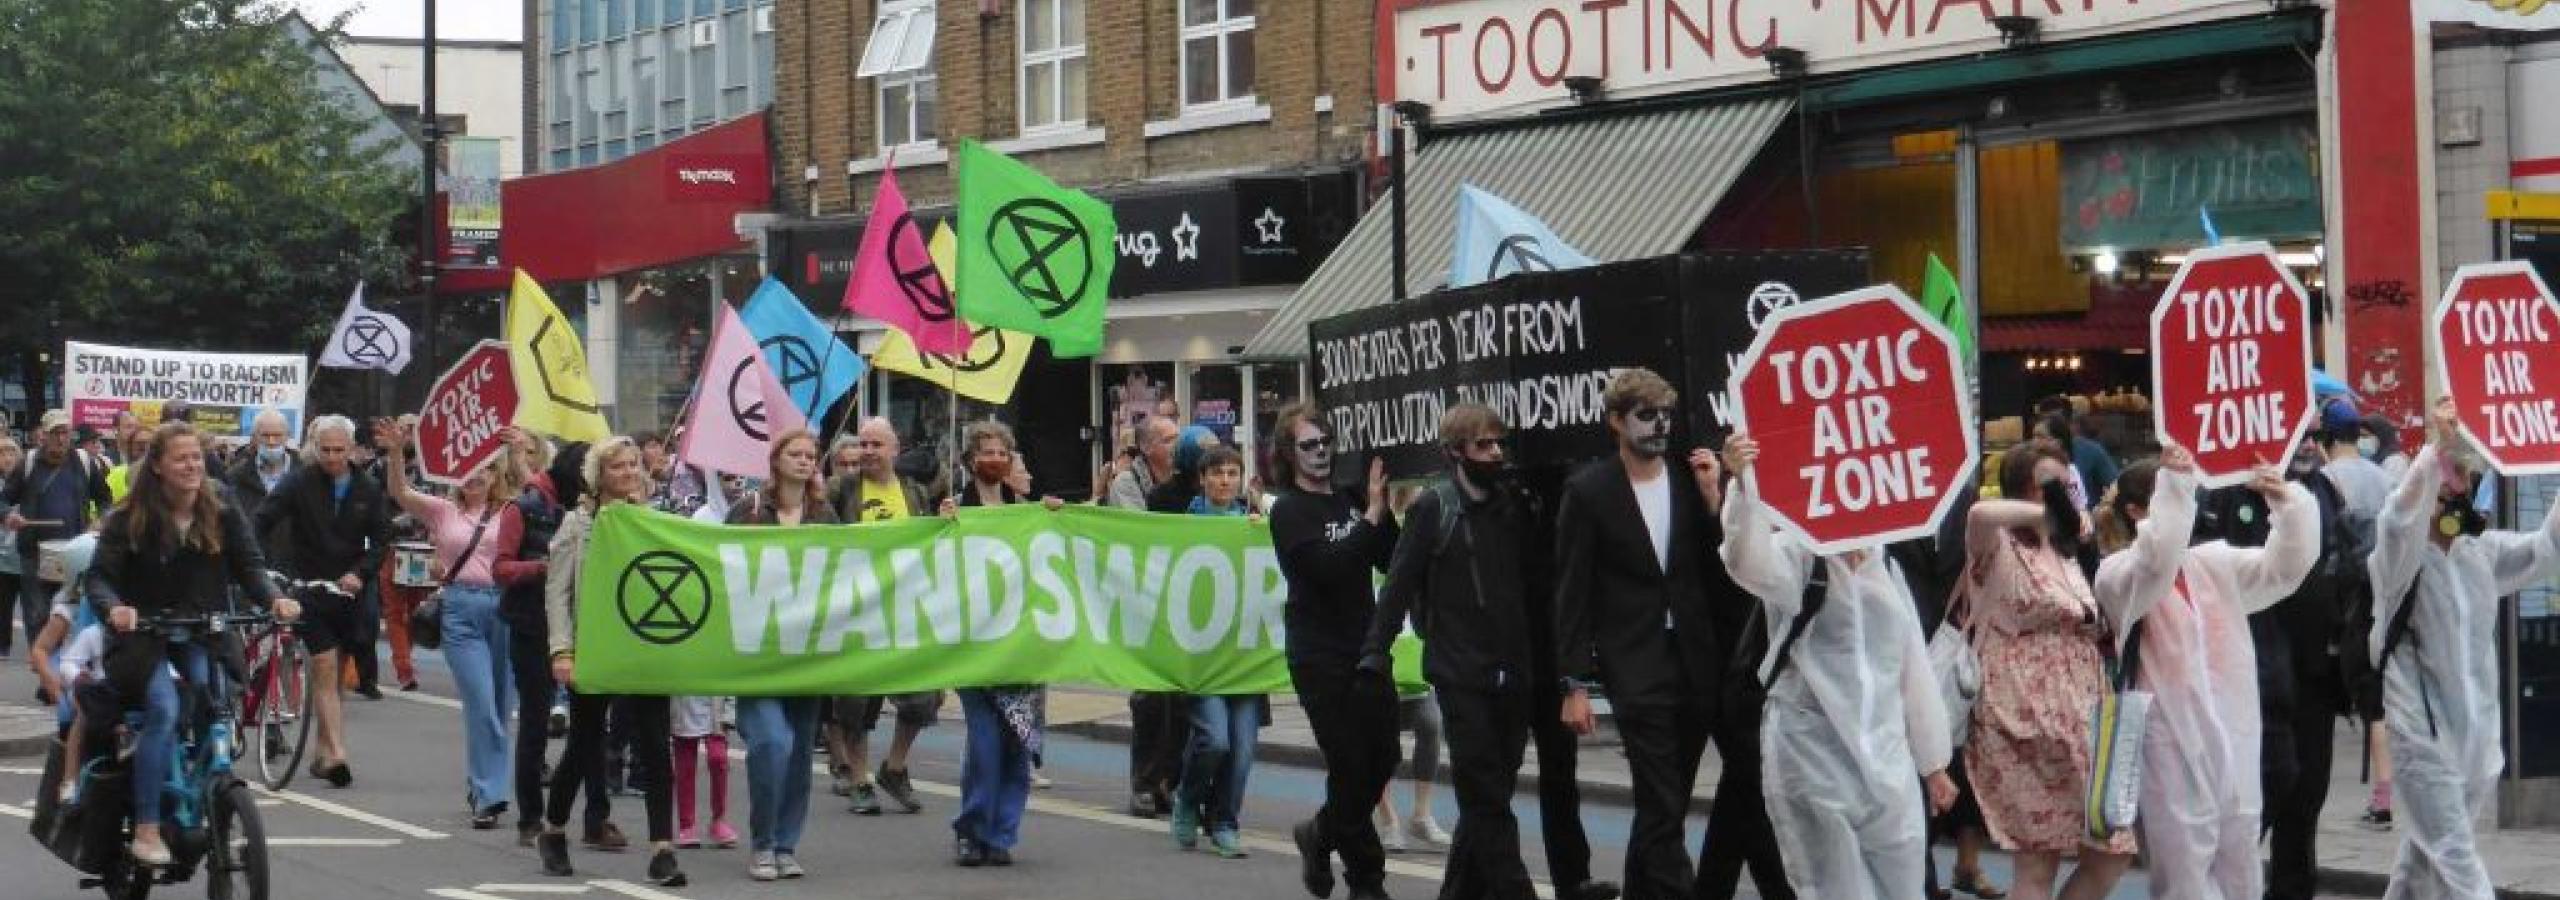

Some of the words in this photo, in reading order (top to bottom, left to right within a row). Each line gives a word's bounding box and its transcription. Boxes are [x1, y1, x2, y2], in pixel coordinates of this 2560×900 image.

[1419, 0, 1778, 101] TOOTING
[1316, 340, 1350, 390] 300
[1349, 328, 1410, 382] DEATHS
[1409, 318, 1446, 372] PER
[1448, 305, 1499, 363] YEAR
[1504, 296, 1585, 357] FROM
[2180, 283, 2286, 342] TOXIC
[2454, 298, 2549, 346] TOXIC
[76, 353, 146, 376] STAND
[152, 359, 180, 377] UP
[188, 362, 215, 379] TO
[220, 363, 298, 385] RACISM
[110, 377, 263, 404] WANDSWORTH
[429, 355, 494, 428] TOXIC
[1769, 329, 1928, 405] TOXIC
[2207, 339, 2262, 394] AIR
[2484, 350, 2535, 397] AIR
[441, 405, 504, 473] ZONE
[446, 393, 482, 442] AIR
[1354, 388, 1447, 450] POLLUTION
[1814, 395, 1896, 457] AIR
[2193, 391, 2287, 453] ZONE
[2480, 398, 2560, 448] ZONE
[1800, 446, 1936, 520] ZONE
[719, 532, 1289, 656] WANDSWOR
